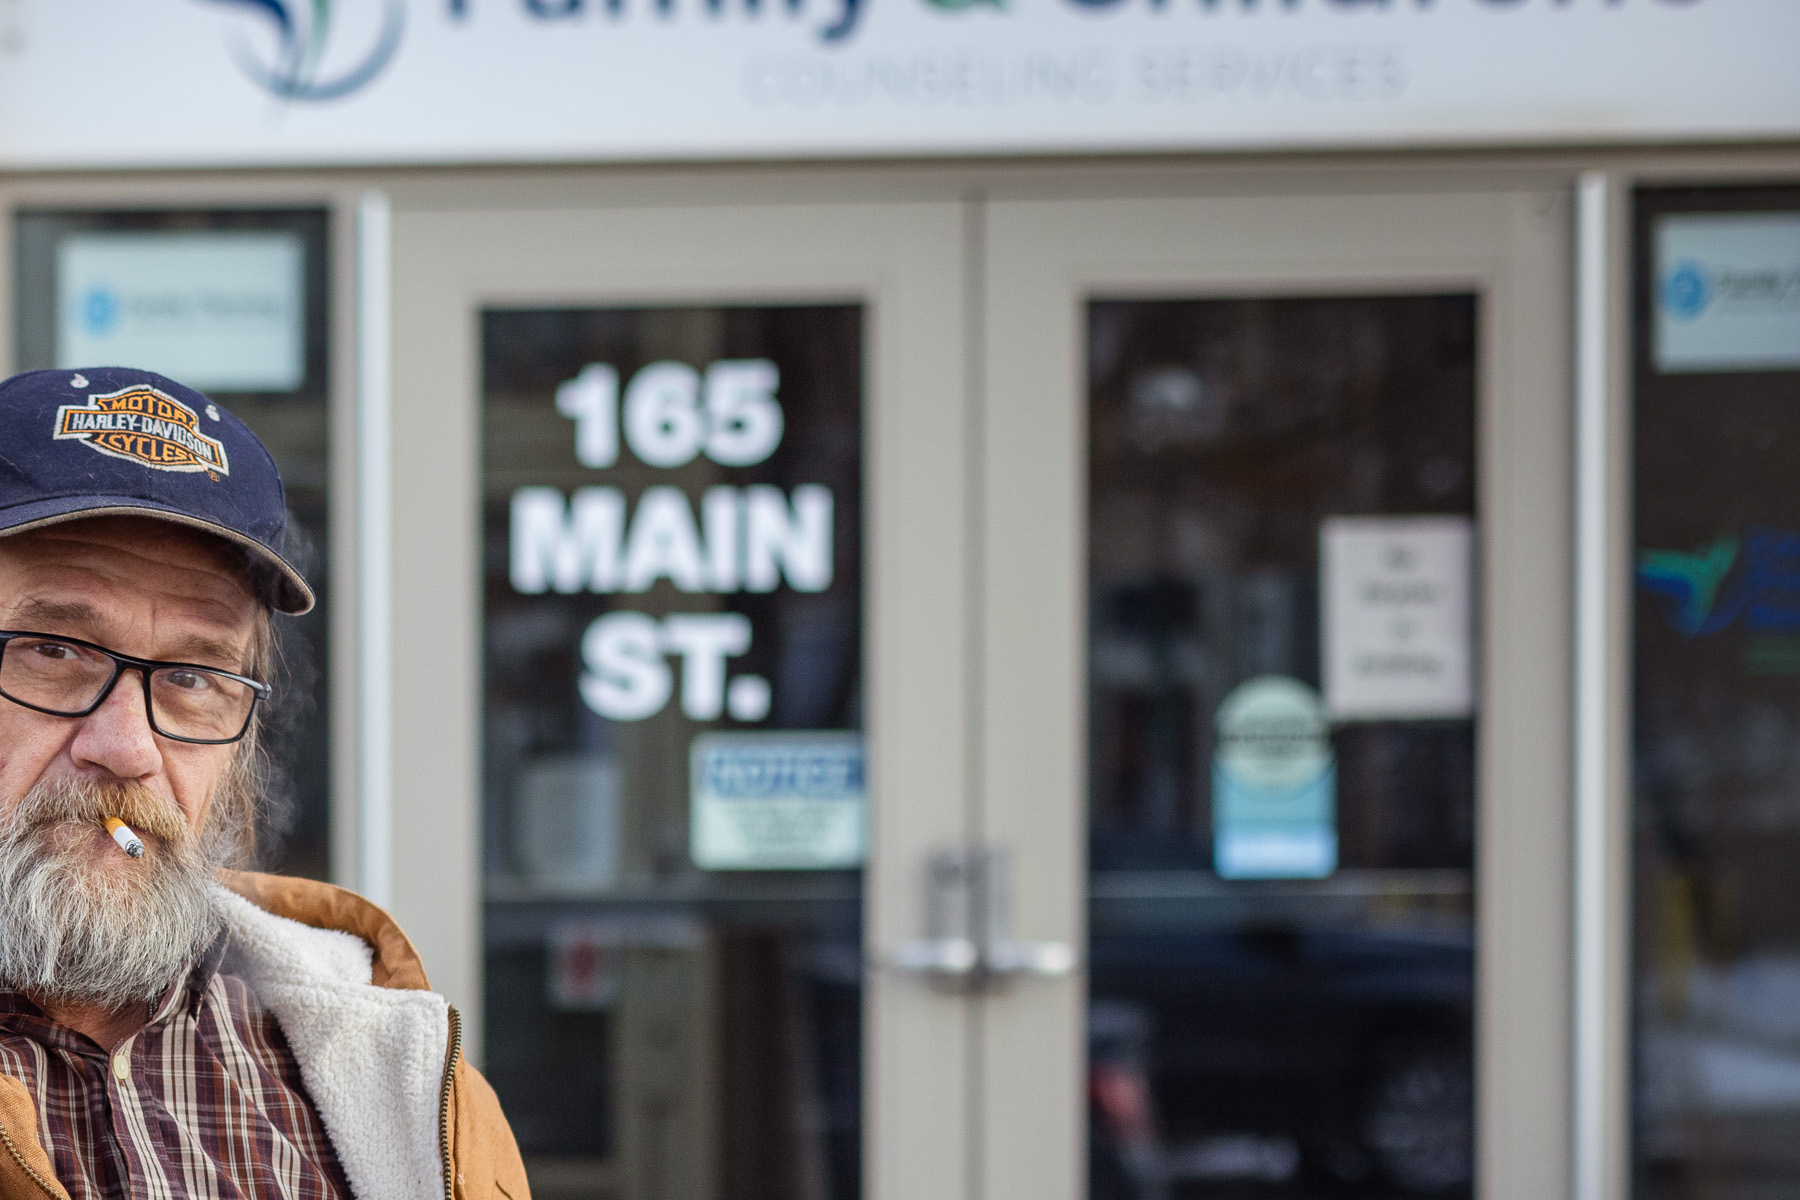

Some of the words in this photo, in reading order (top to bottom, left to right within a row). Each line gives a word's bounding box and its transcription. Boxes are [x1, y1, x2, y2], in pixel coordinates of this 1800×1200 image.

[740, 45, 1117, 110] COUNSELING
[1130, 41, 1410, 105] SERVICES
[71, 412, 213, 461] HARLEY-DAVIDSON
[111, 395, 188, 423] MOTOR
[555, 358, 784, 469] 165
[108, 433, 188, 462] CYCLES
[509, 484, 835, 594] MAIN
[578, 610, 772, 722] ST.
